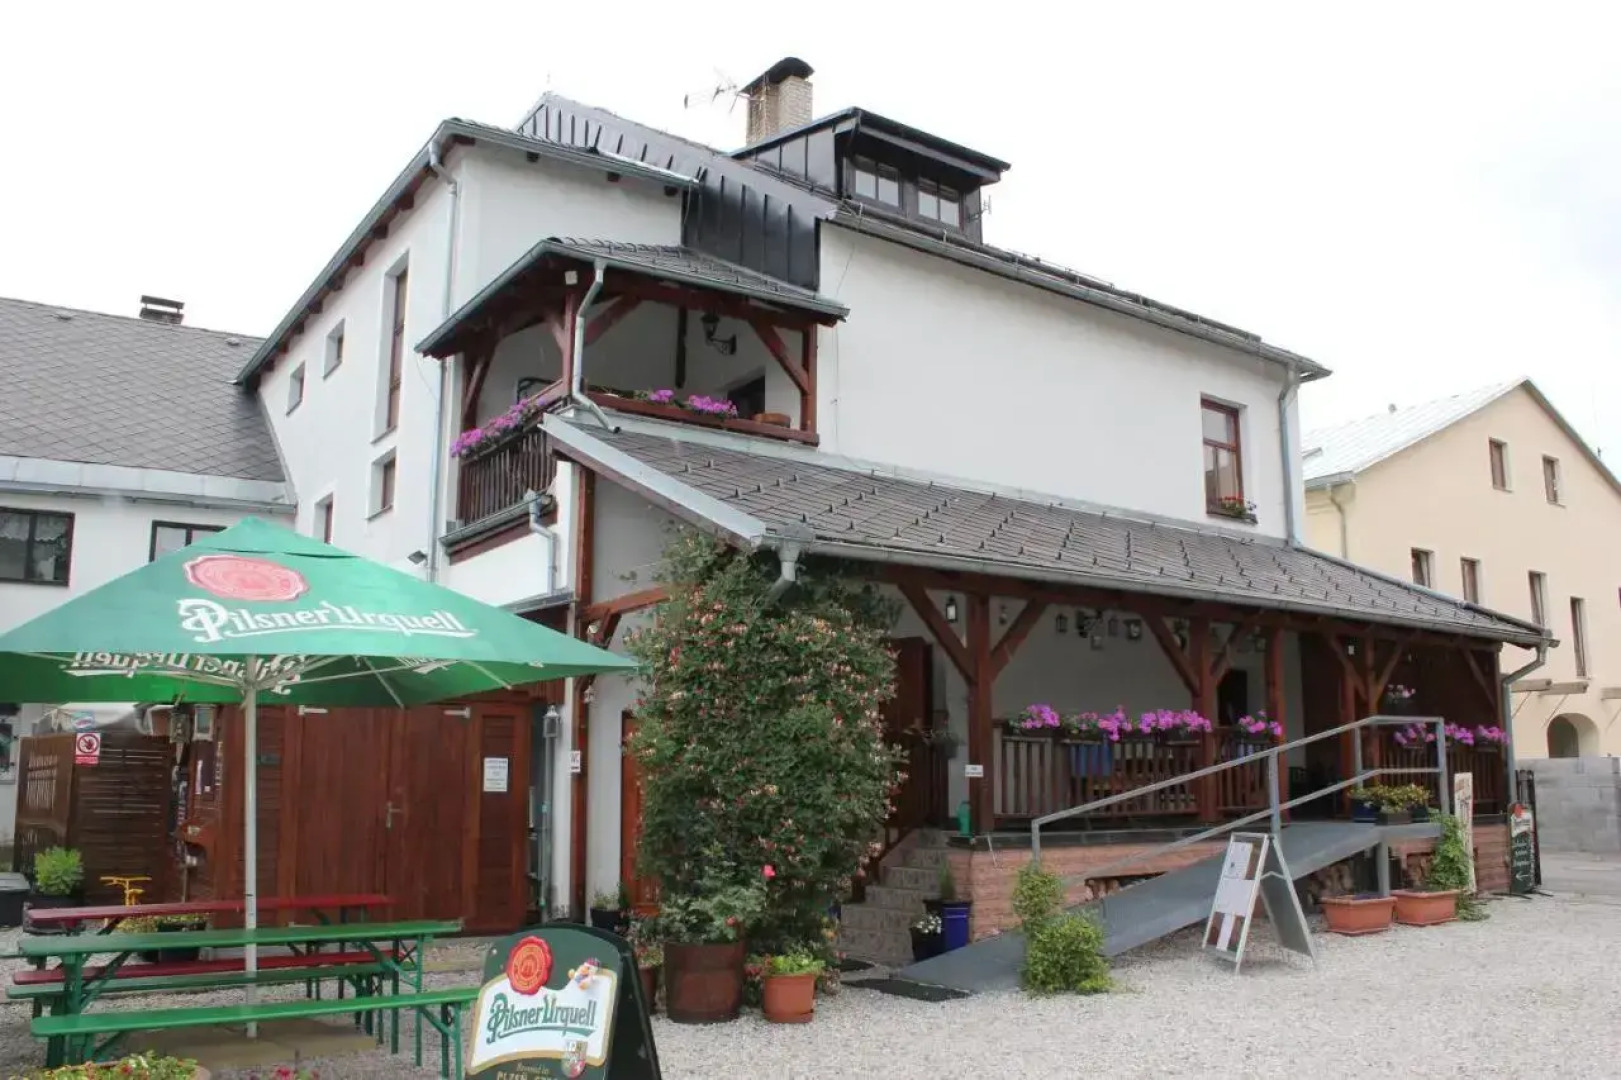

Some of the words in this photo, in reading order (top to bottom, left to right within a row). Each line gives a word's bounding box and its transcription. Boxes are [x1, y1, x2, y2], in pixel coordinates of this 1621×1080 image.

[177, 599, 331, 642] Pilsner
[320, 600, 467, 637] Urquell
[486, 993, 543, 1044] Pilsner
[543, 993, 597, 1036] Urquell
